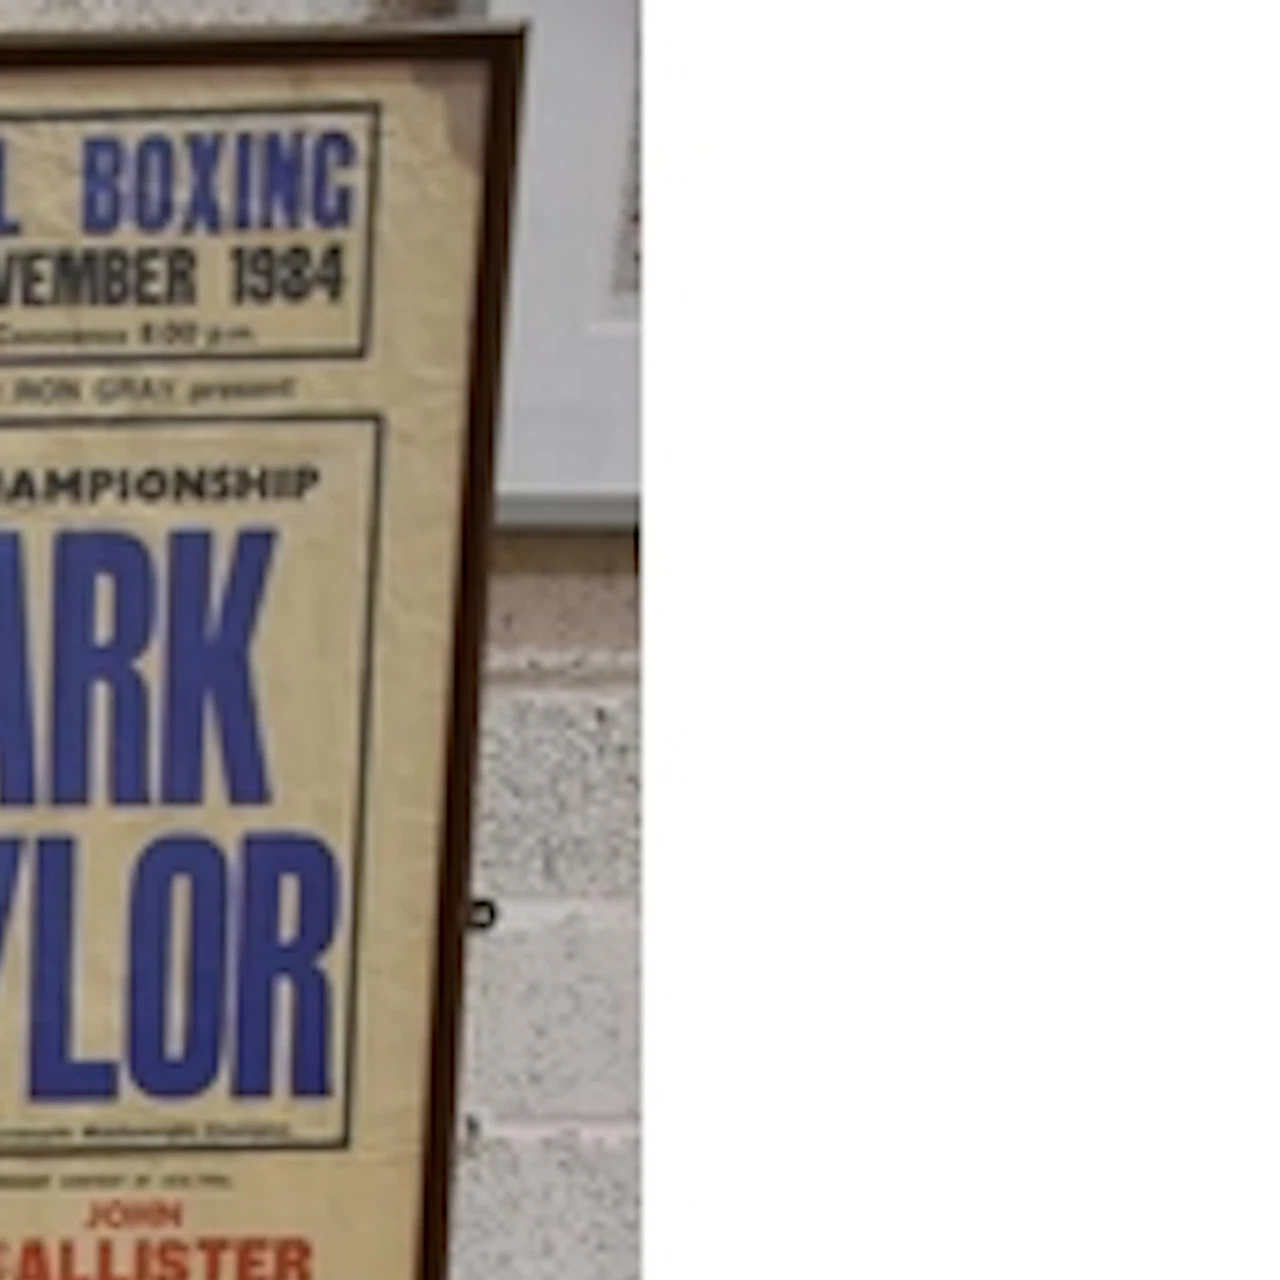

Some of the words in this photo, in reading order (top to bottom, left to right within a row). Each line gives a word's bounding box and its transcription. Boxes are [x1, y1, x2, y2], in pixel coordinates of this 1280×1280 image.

[81, 131, 358, 236] BOXING
[230, 244, 345, 305] 1984
[83, 1199, 185, 1230] JOHN
